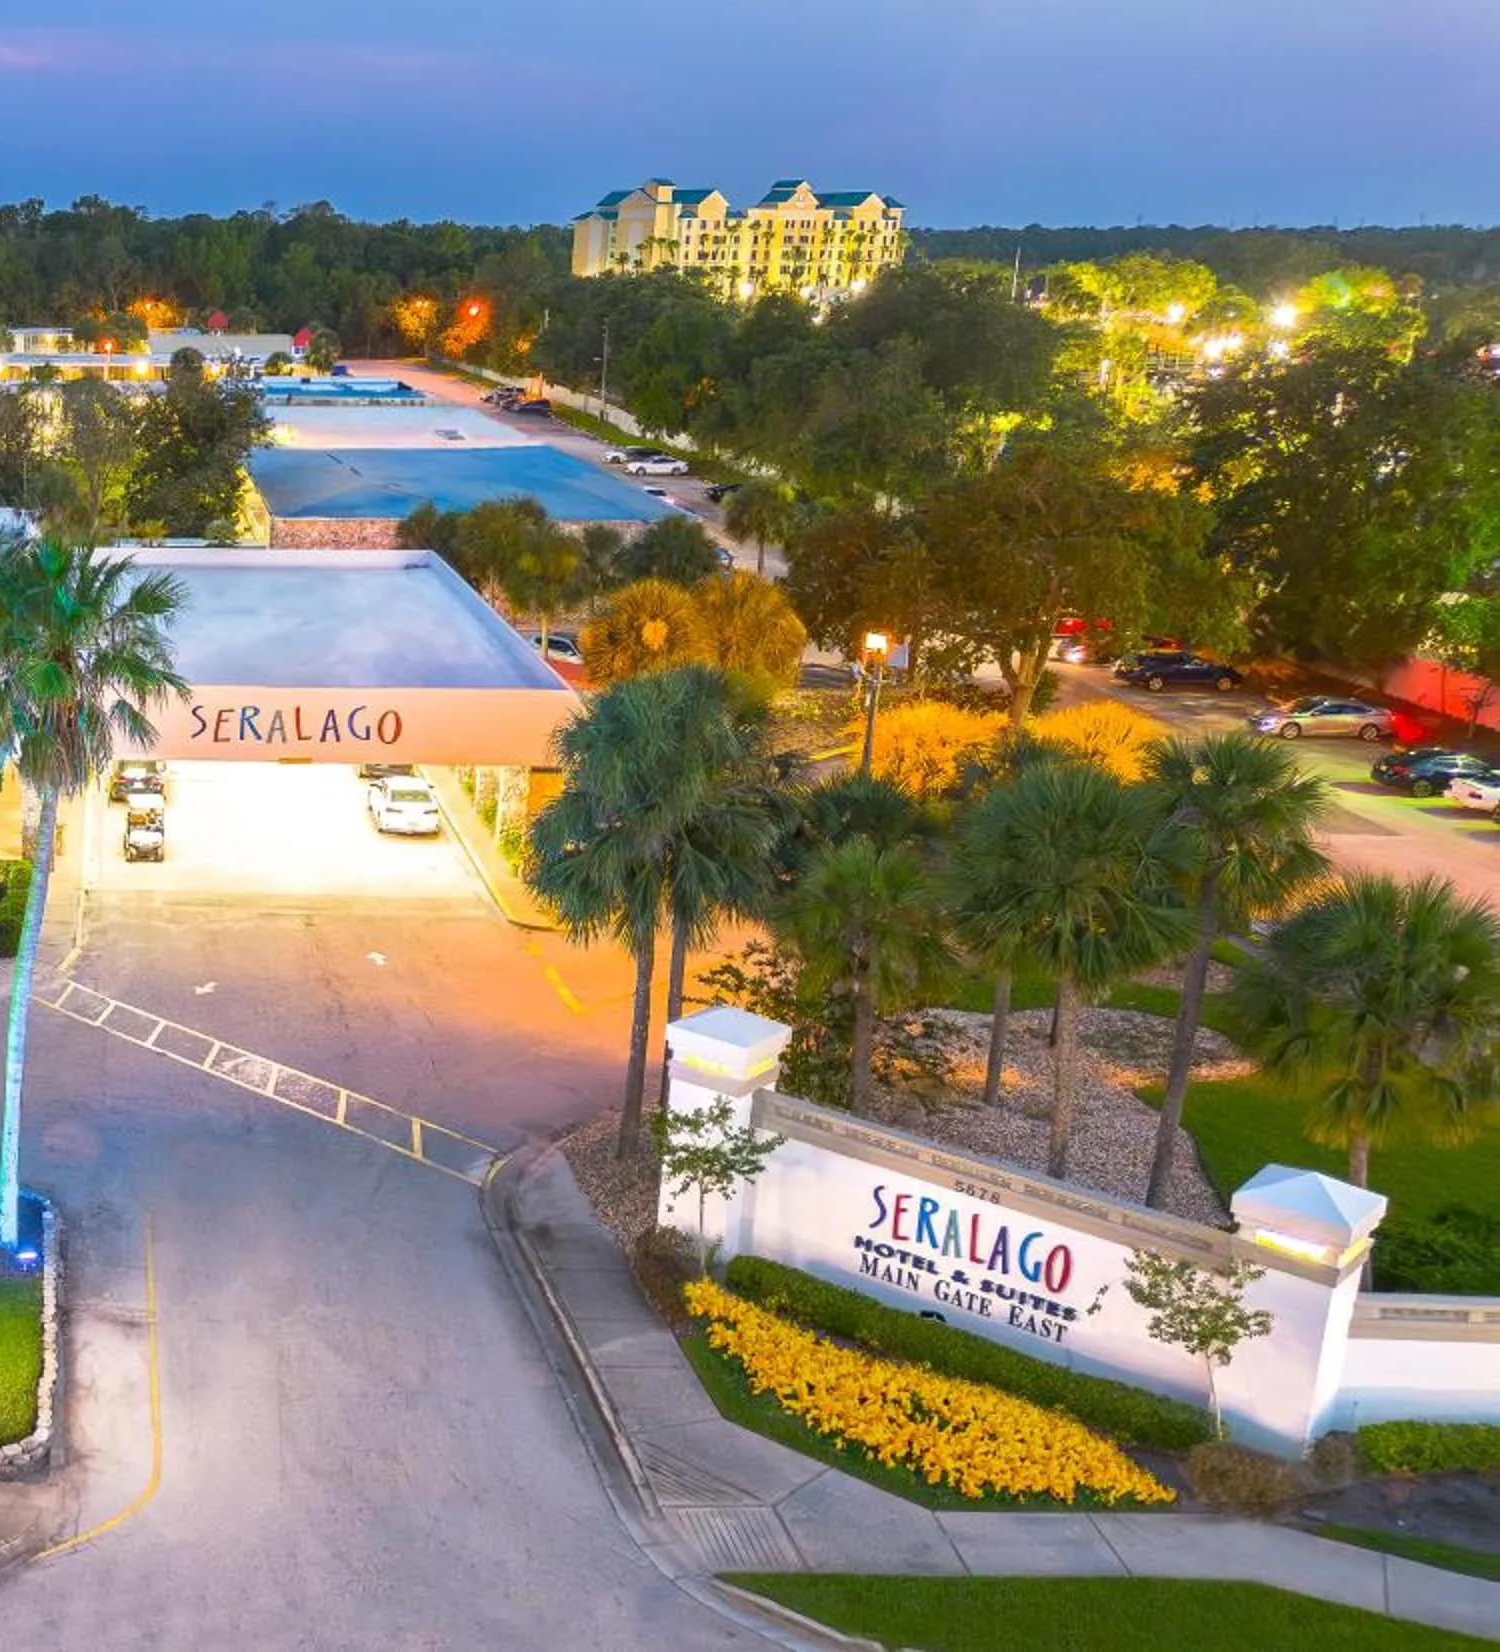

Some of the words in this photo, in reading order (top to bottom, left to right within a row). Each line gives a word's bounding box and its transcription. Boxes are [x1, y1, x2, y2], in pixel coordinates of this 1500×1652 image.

[190, 704, 403, 745] SERALAGO
[953, 1179, 1001, 1204] 5678
[853, 1234, 940, 1276] HOTEL
[950, 1269, 971, 1286] &
[979, 1278, 1078, 1322] SUITES
[868, 1185, 1073, 1294] SERALAGO
[859, 1250, 921, 1294] MAIN
[934, 1278, 993, 1319] GATE
[1007, 1303, 1069, 1344] EAST
